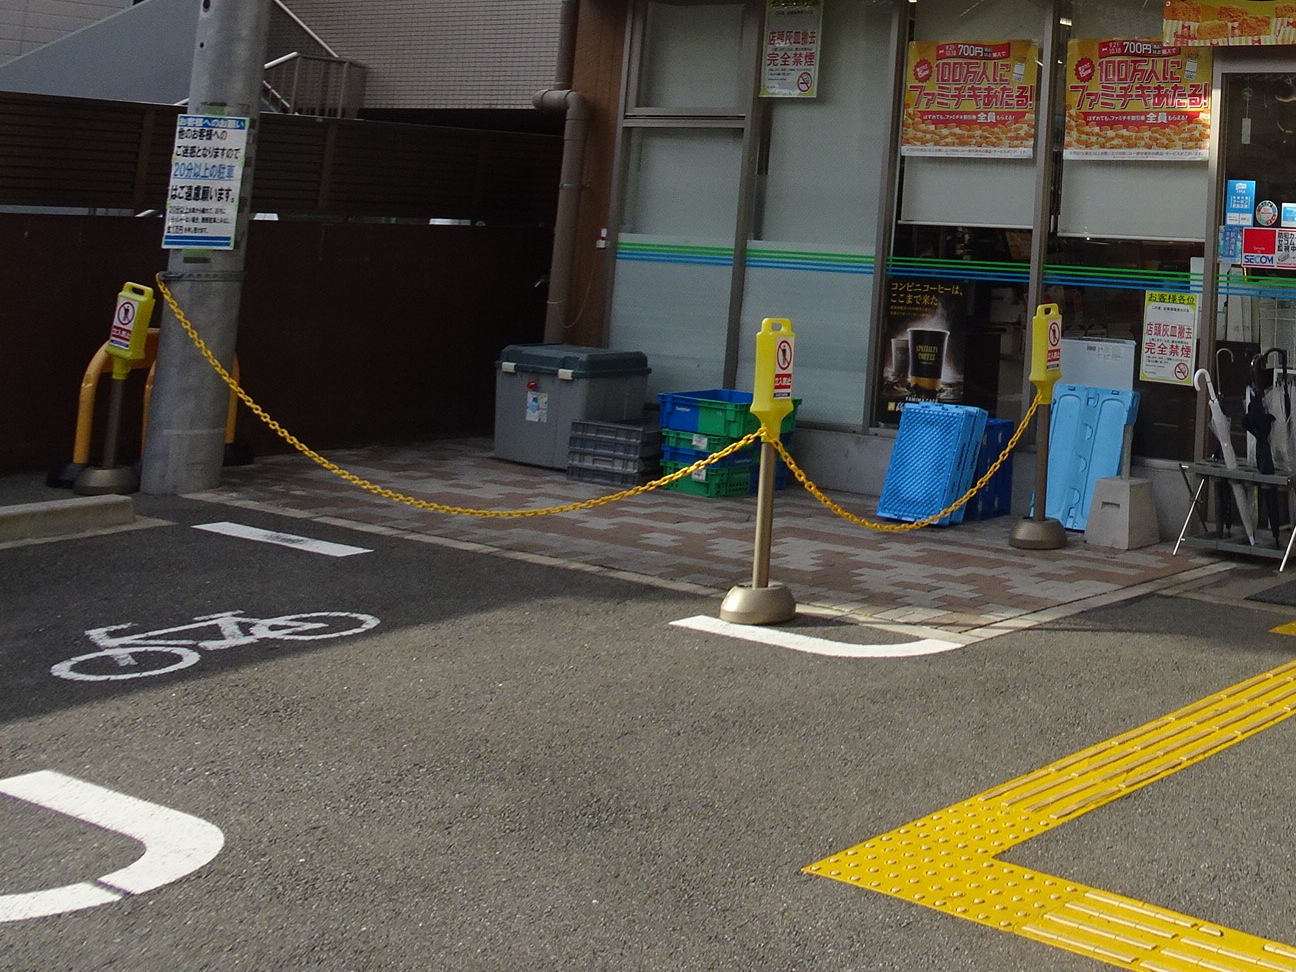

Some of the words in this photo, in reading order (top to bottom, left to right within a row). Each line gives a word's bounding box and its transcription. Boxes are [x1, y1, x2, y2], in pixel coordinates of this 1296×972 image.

[958, 44, 983, 57] 700円
[1122, 41, 1152, 54] 700円
[767, 51, 815, 67] 完全禁煙
[935, 60, 1012, 84] 100万人に
[1098, 58, 1182, 83] 100万人に
[909, 84, 1035, 109] ファミチキあたる!
[1069, 82, 1210, 109] ファミチキあたる!
[177, 128, 228, 140] 他のお客様への
[176, 145, 240, 159] ご迷惑となりますので
[173, 162, 235, 178] 20分以上の駐車
[1244, 254, 1274, 265] SECOM
[891, 282, 963, 296] コンビニコーヒーは、
[1148, 292, 1195, 305] お客様各位
[1144, 342, 1192, 358] 完全禁煙
